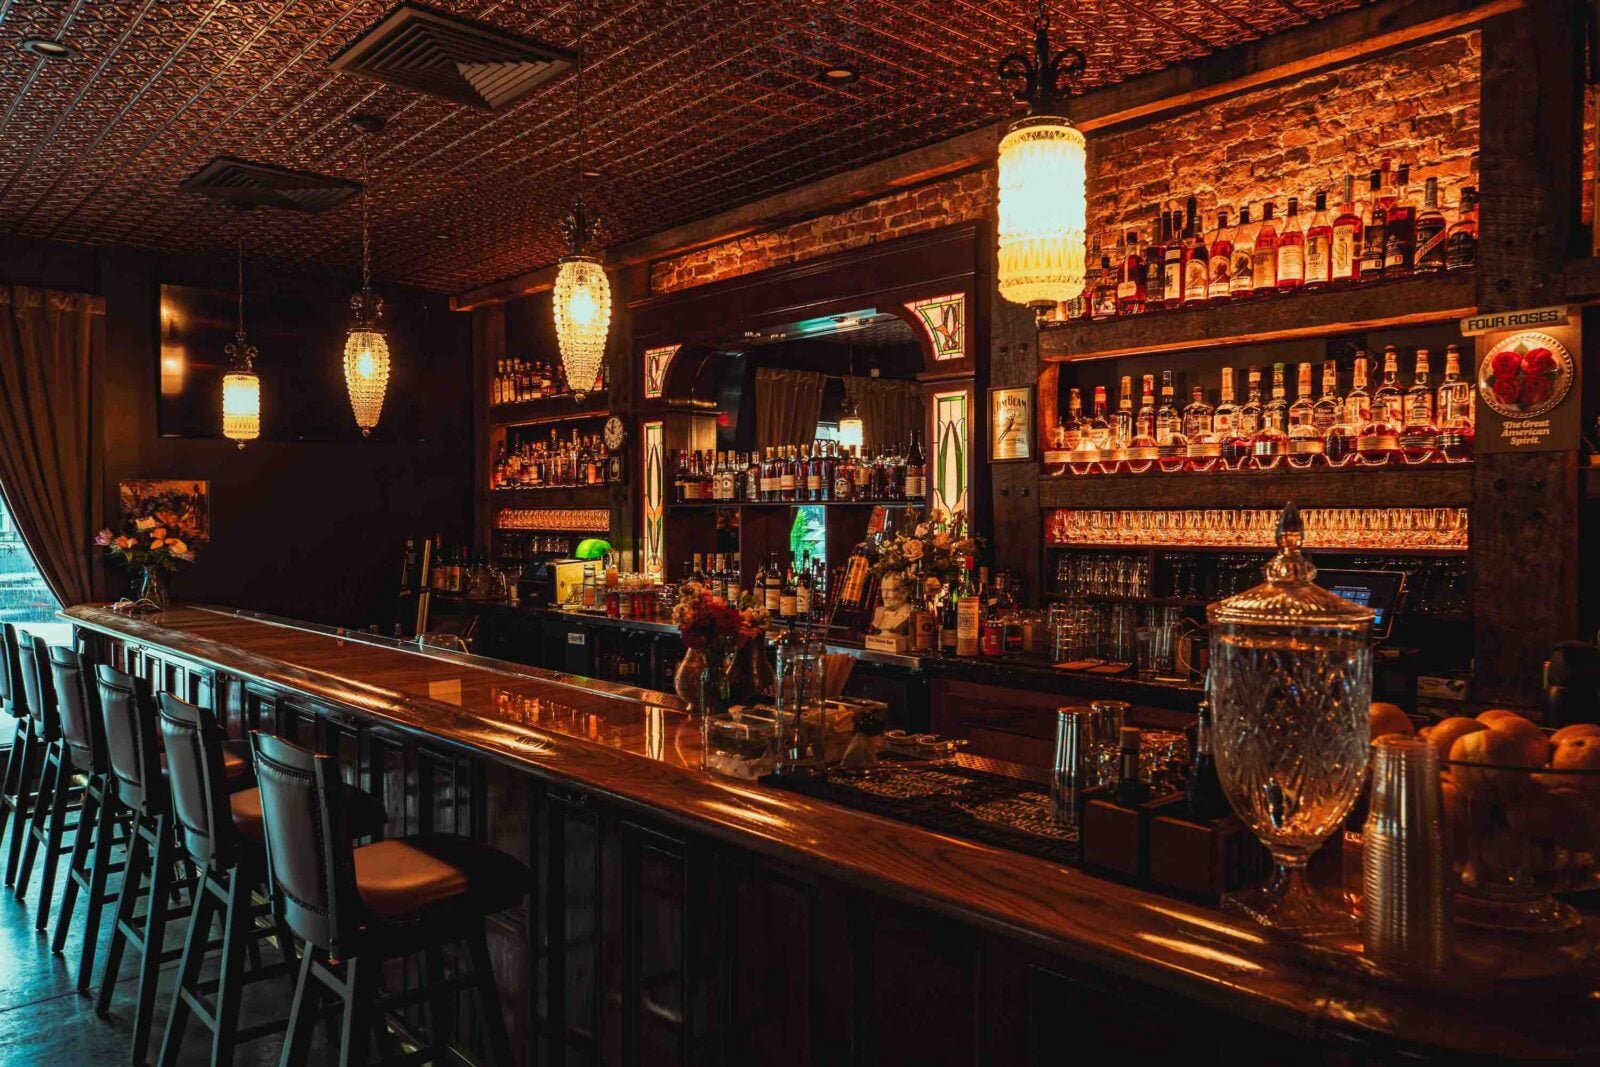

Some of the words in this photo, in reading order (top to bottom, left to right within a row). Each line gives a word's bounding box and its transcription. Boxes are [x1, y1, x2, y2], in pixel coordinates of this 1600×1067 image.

[1468, 316, 1506, 331] FOUR
[1508, 310, 1558, 326] ROSES
[1007, 395, 1027, 411] BEAM
[1502, 421, 1521, 429] The
[1522, 419, 1550, 429] Great
[1500, 427, 1550, 437] American
